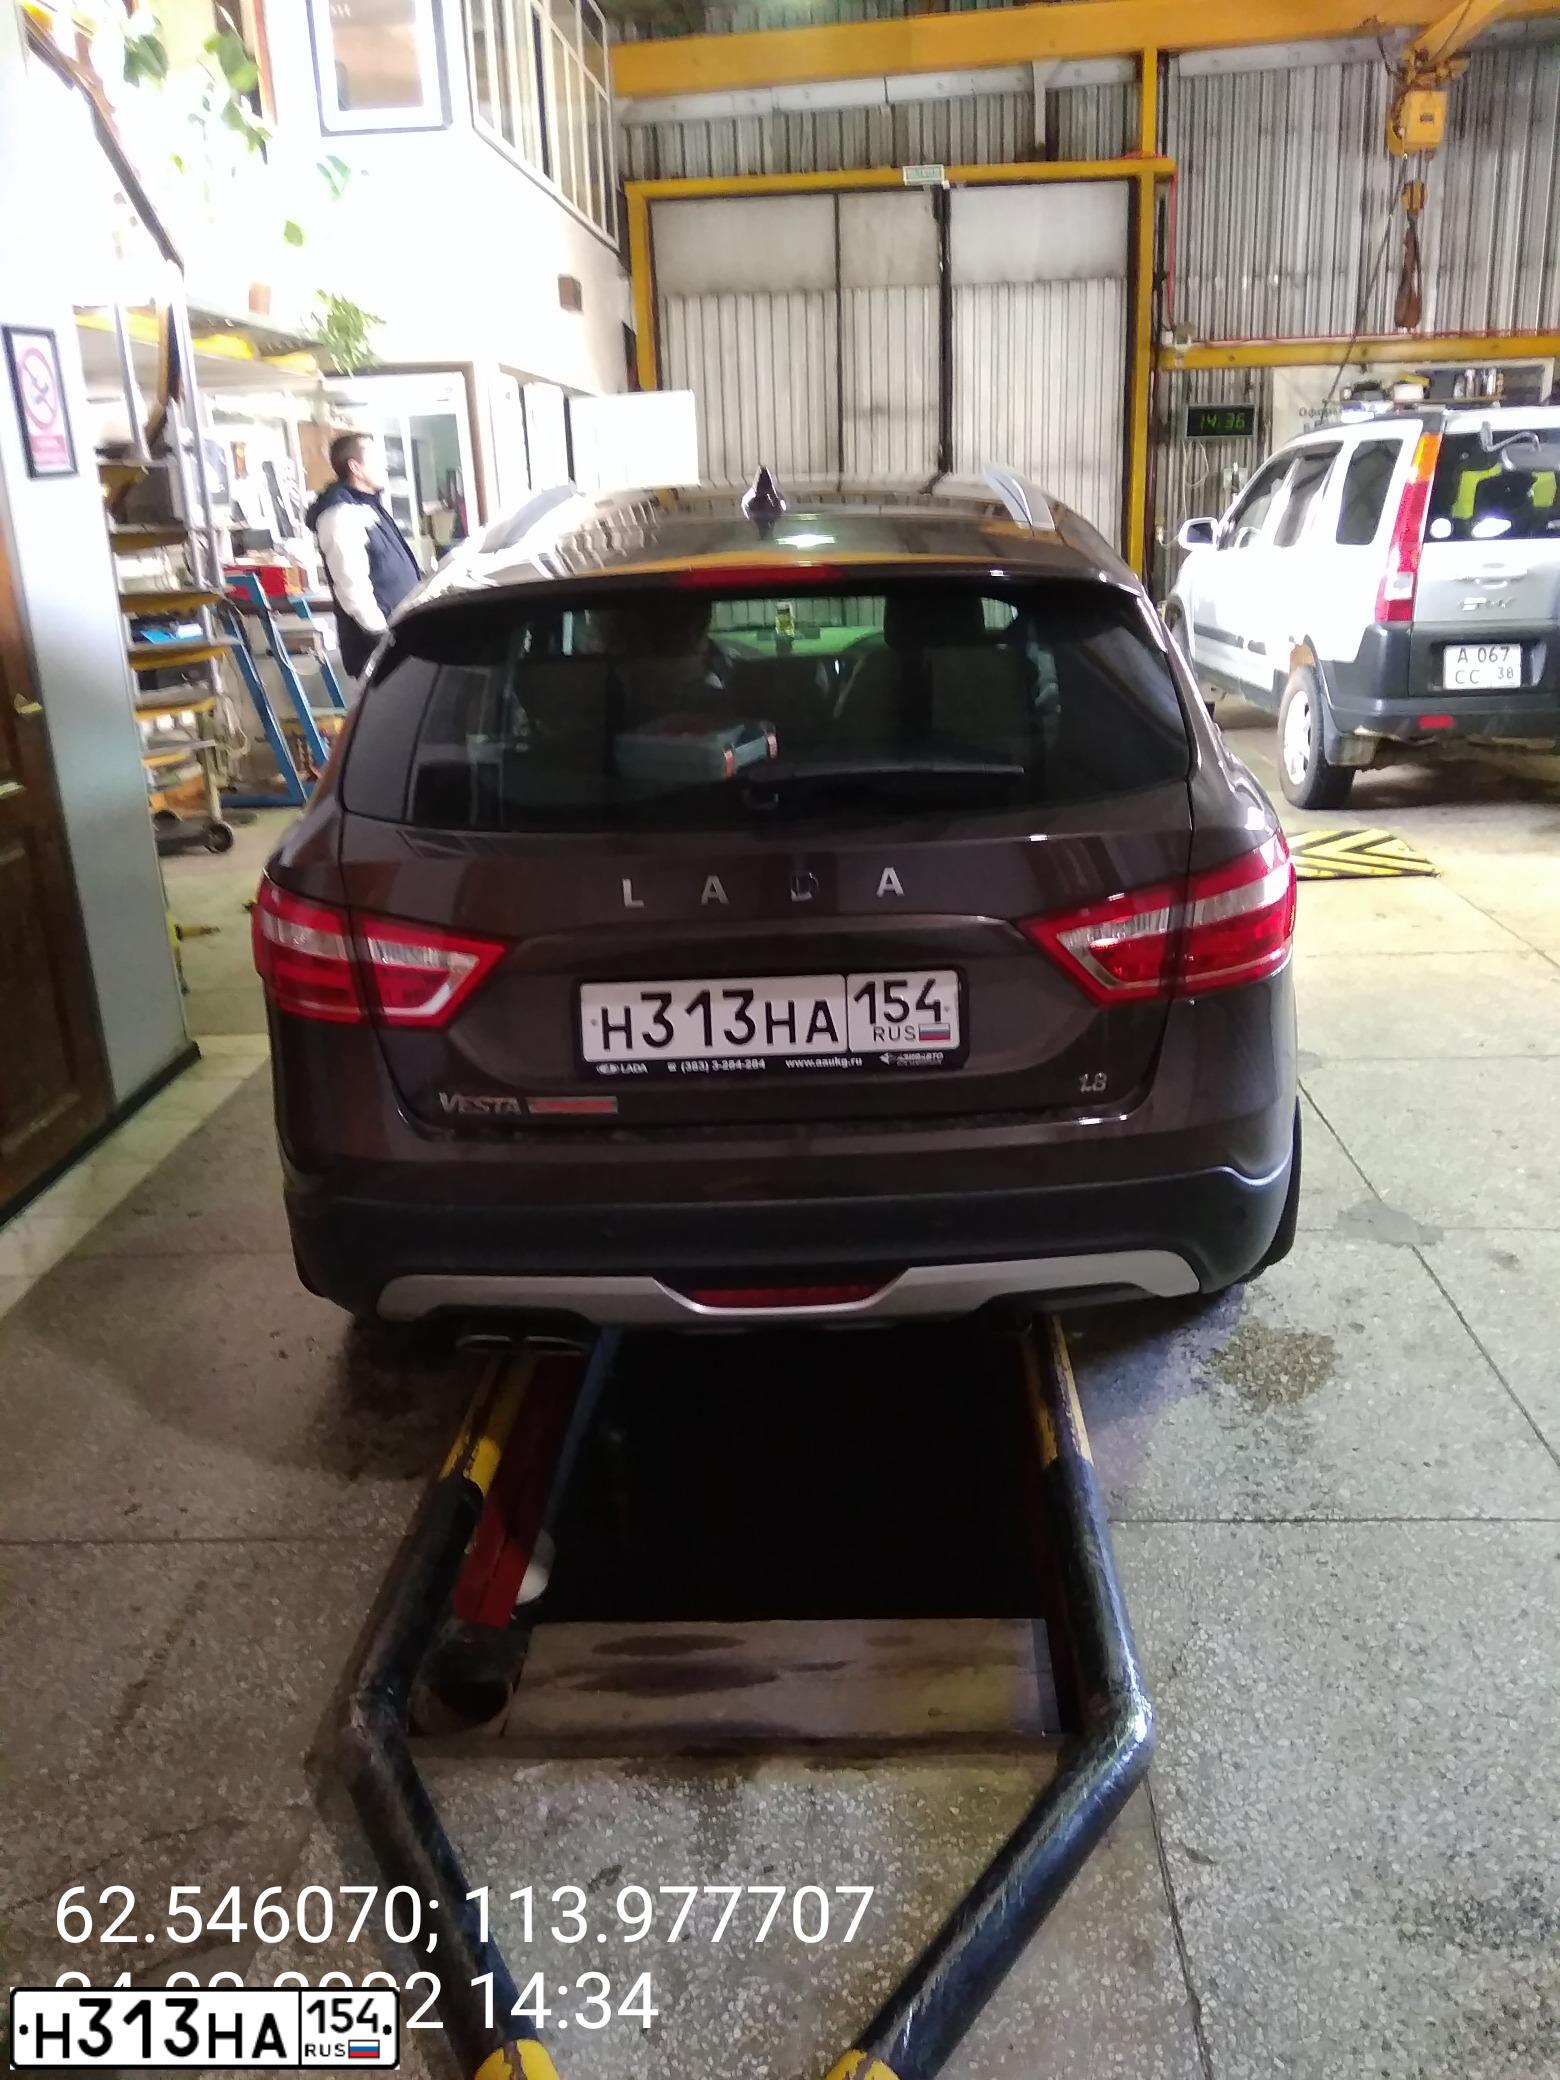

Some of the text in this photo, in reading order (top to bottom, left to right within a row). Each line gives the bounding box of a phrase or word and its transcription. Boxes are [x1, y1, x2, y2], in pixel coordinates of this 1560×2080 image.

[1457, 646, 1510, 664] А 067
[1455, 667, 1514, 685] СС 38
[601, 977, 943, 1051] Н313НА 154
[872, 1025, 917, 1043] RUS
[437, 1091, 522, 1114] VESTA
